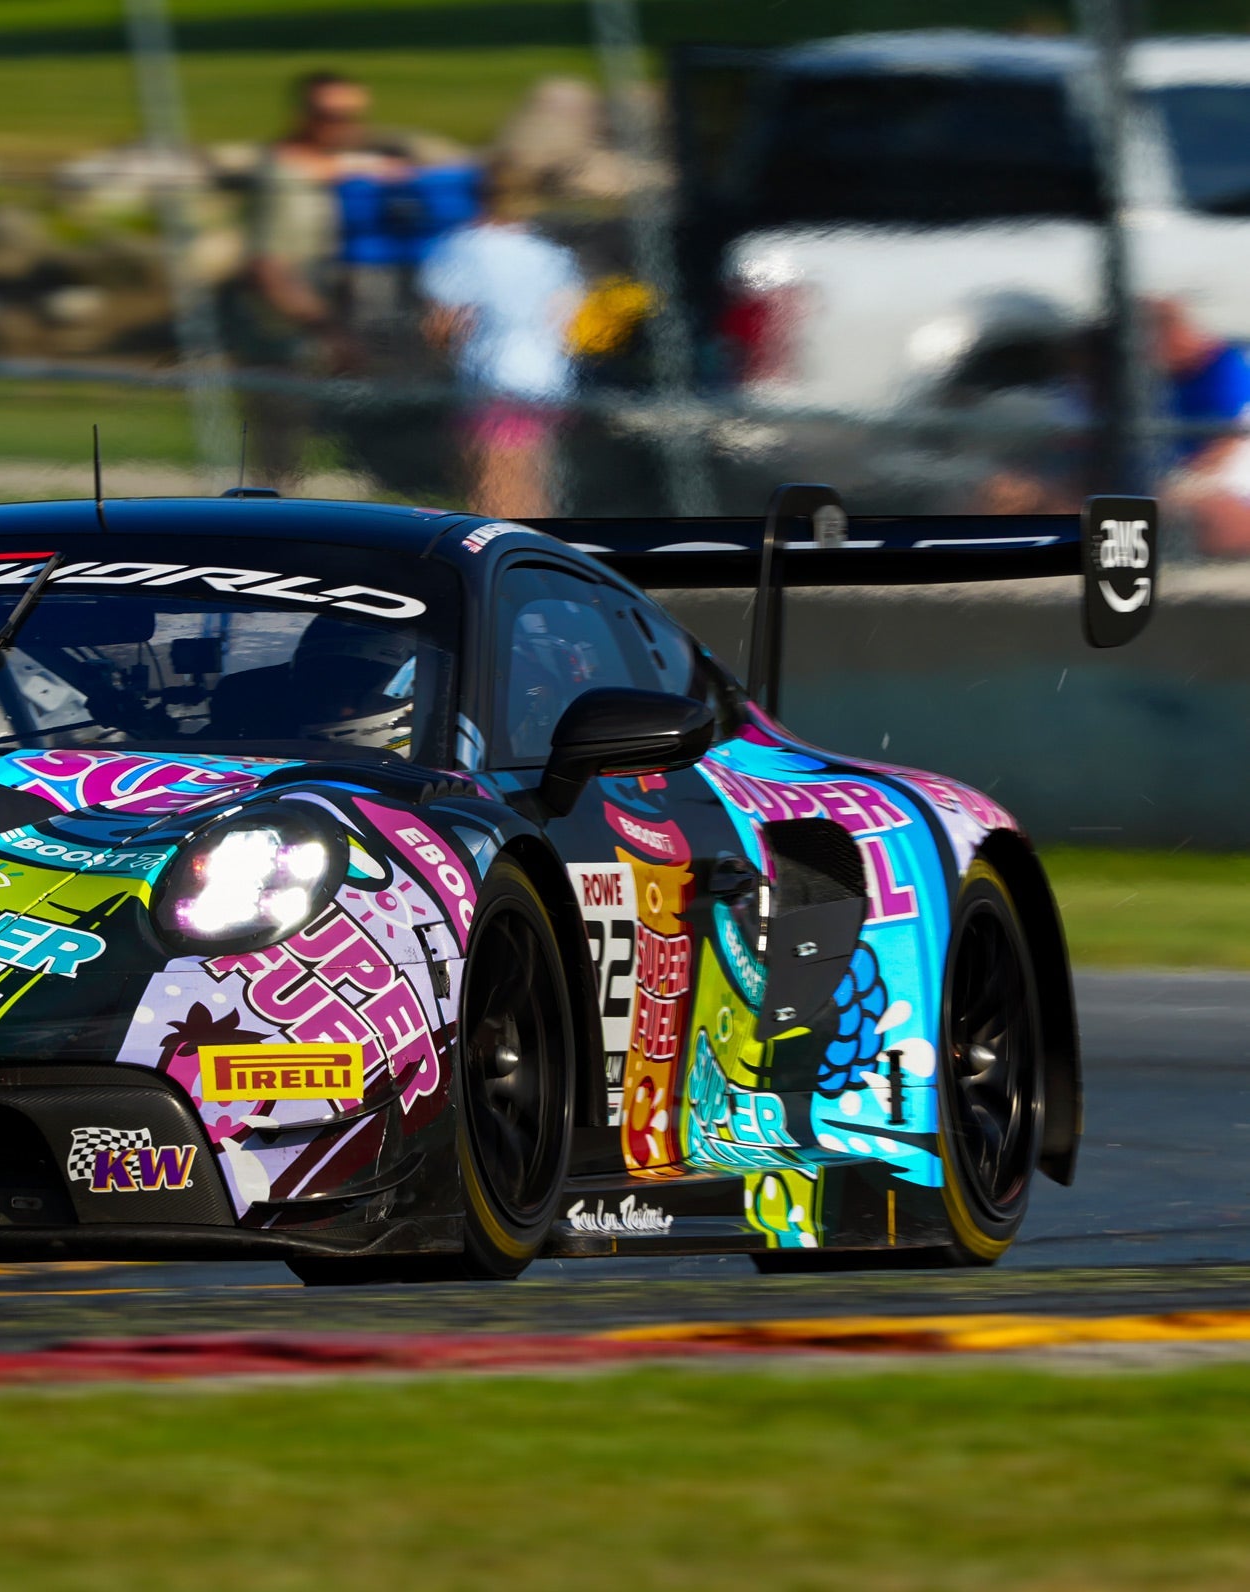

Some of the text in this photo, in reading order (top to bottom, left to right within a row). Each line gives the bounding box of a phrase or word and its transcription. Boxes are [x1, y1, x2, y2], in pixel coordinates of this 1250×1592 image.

[395, 827, 475, 931] EBOO
[581, 873, 623, 906] ROWE
[635, 920, 690, 998] SUPER
[283, 901, 441, 1115] UPER
[213, 1053, 353, 1091] PIRELLI
[89, 1144, 198, 1193] KW
